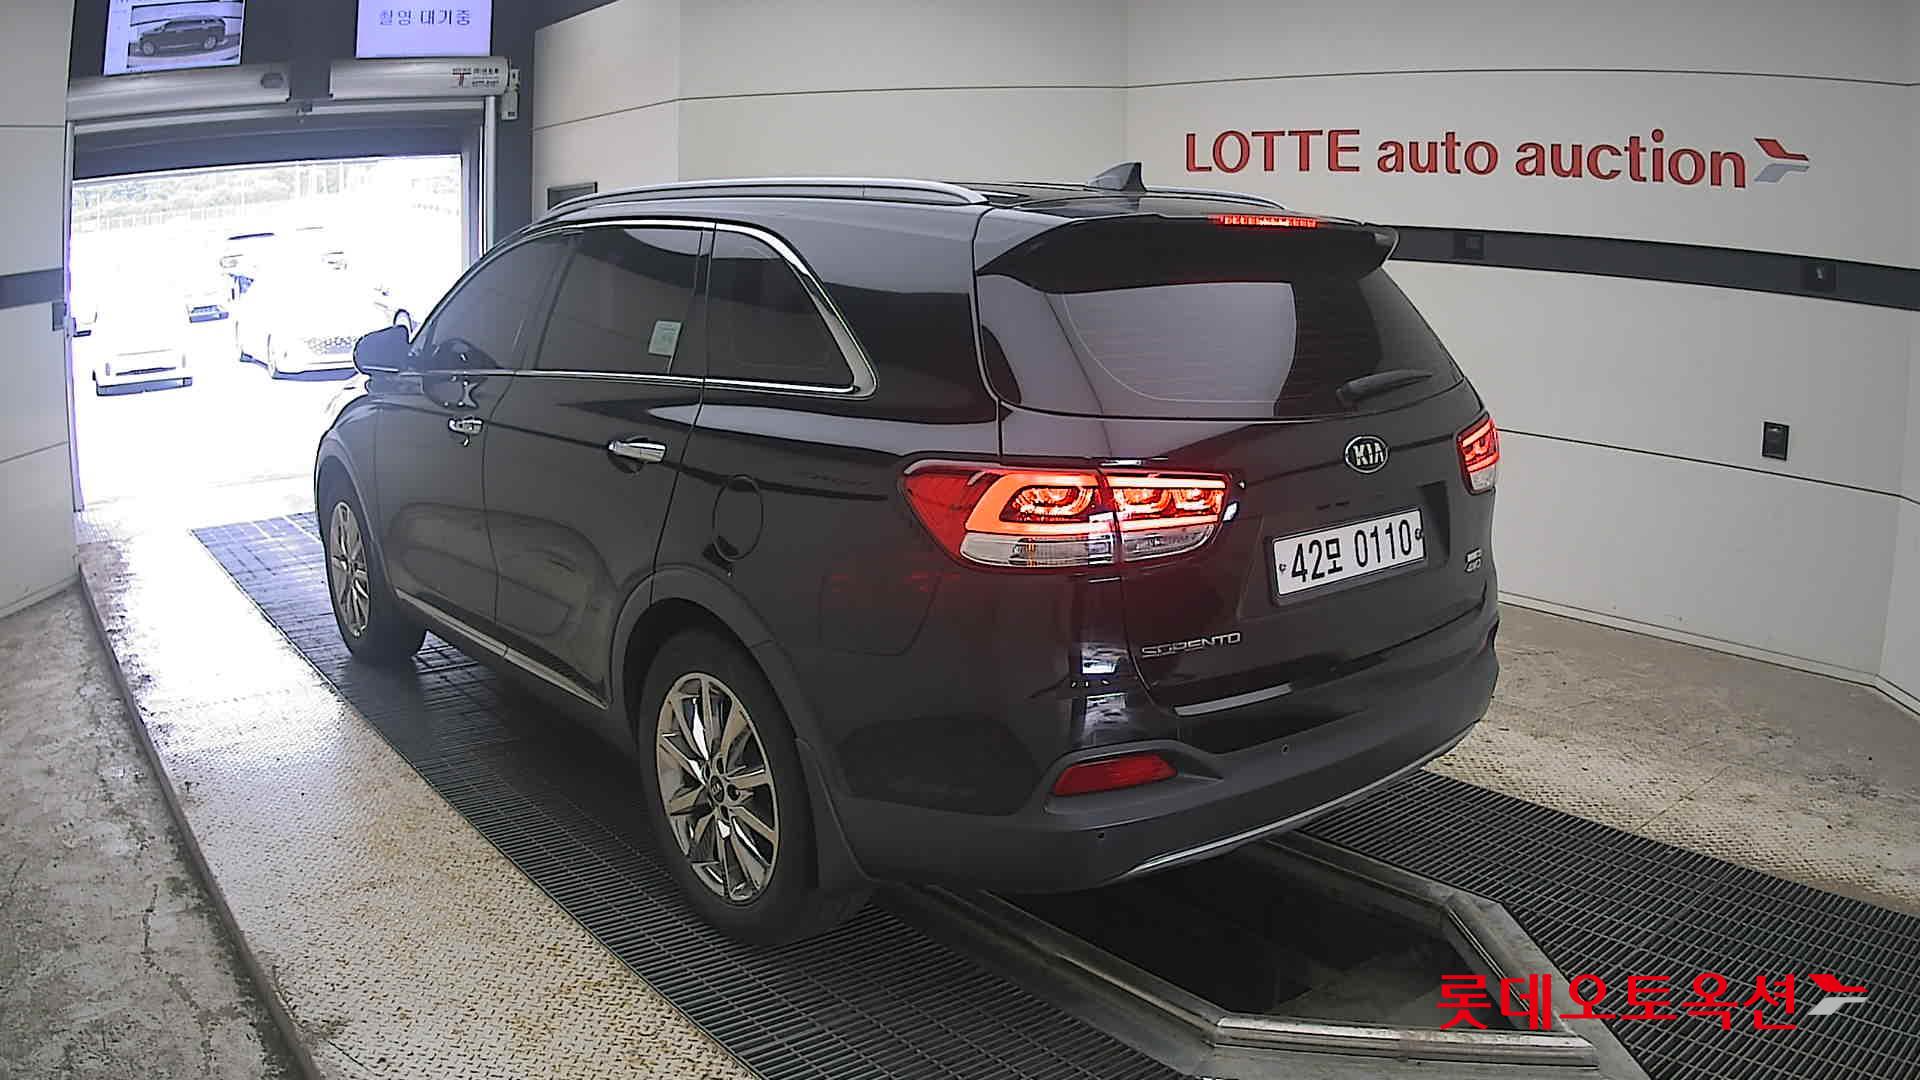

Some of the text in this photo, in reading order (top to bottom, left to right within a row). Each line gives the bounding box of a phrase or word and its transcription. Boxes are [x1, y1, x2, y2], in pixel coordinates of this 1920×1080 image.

[1186, 128, 1747, 188] LOTTE auto auction
[1352, 442, 1385, 467] KIA
[1291, 519, 1412, 583] 42모 0110
[1141, 632, 1241, 659] SORENTO
